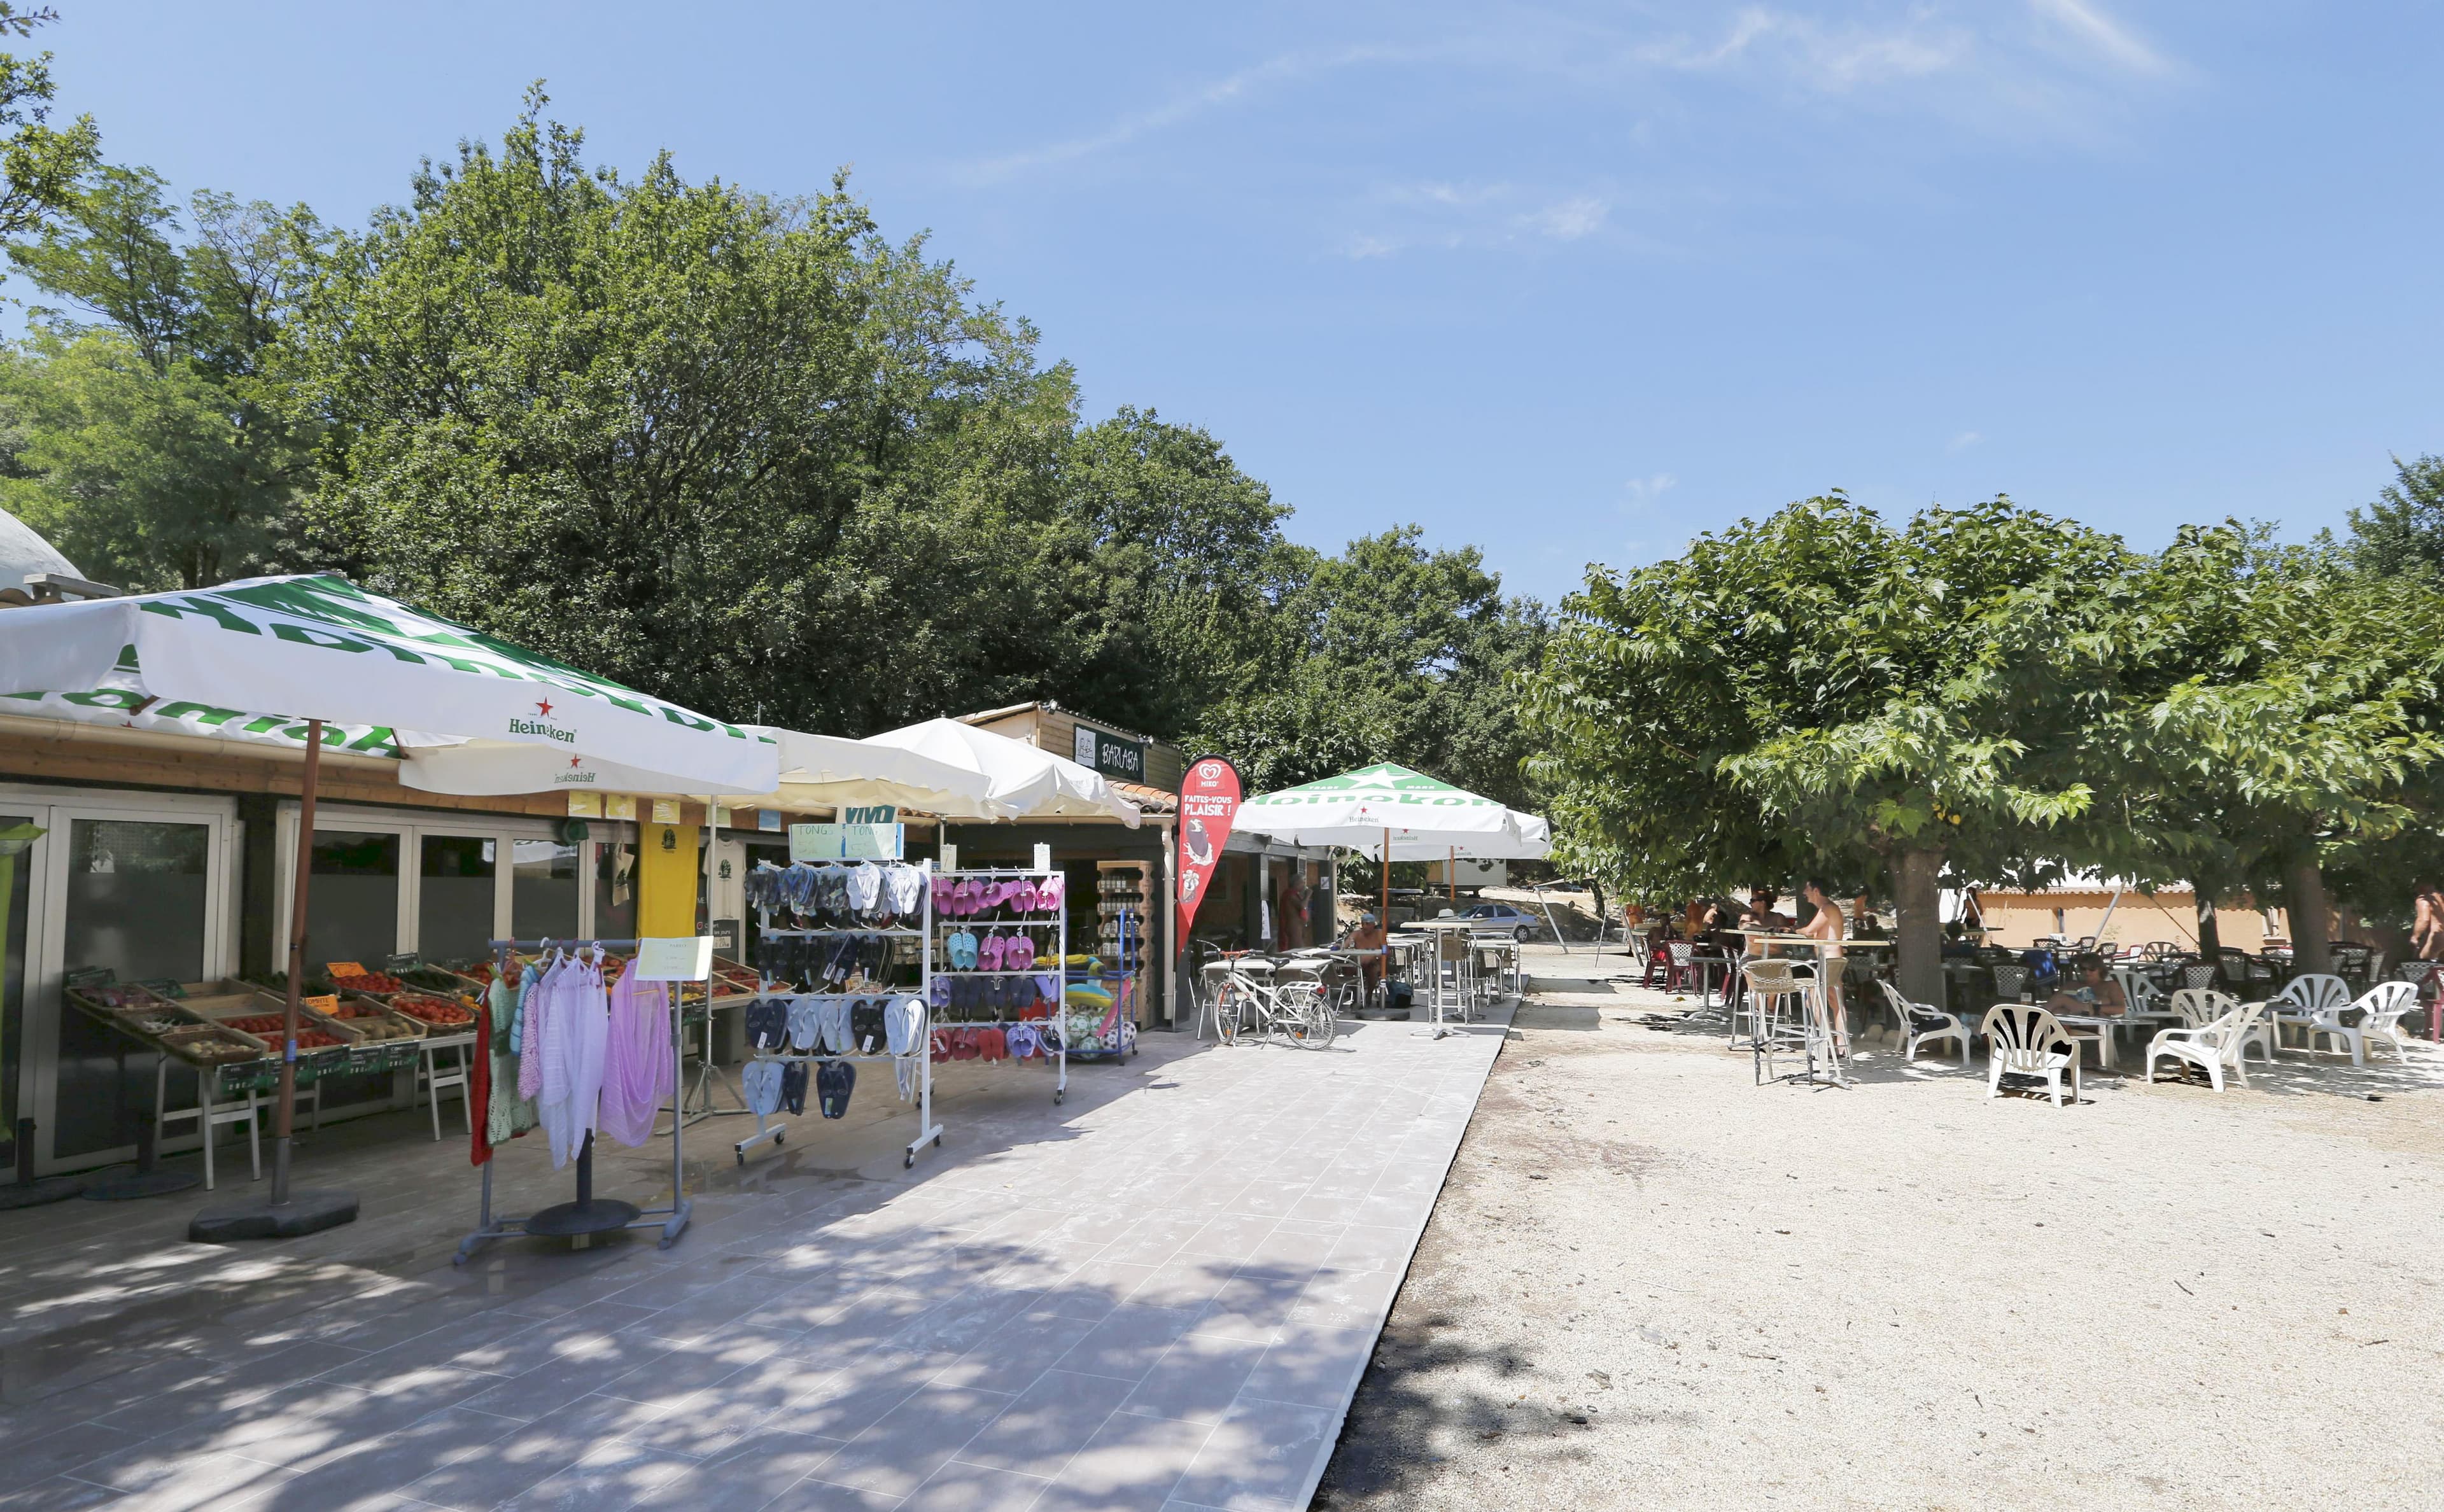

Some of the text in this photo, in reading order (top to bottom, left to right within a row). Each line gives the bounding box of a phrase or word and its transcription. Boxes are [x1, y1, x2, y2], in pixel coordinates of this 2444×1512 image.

[509, 718, 575, 743] Heineken
[1184, 795, 1232, 804] FAITES-VOUS
[1184, 803, 1225, 816] PLAISIR
